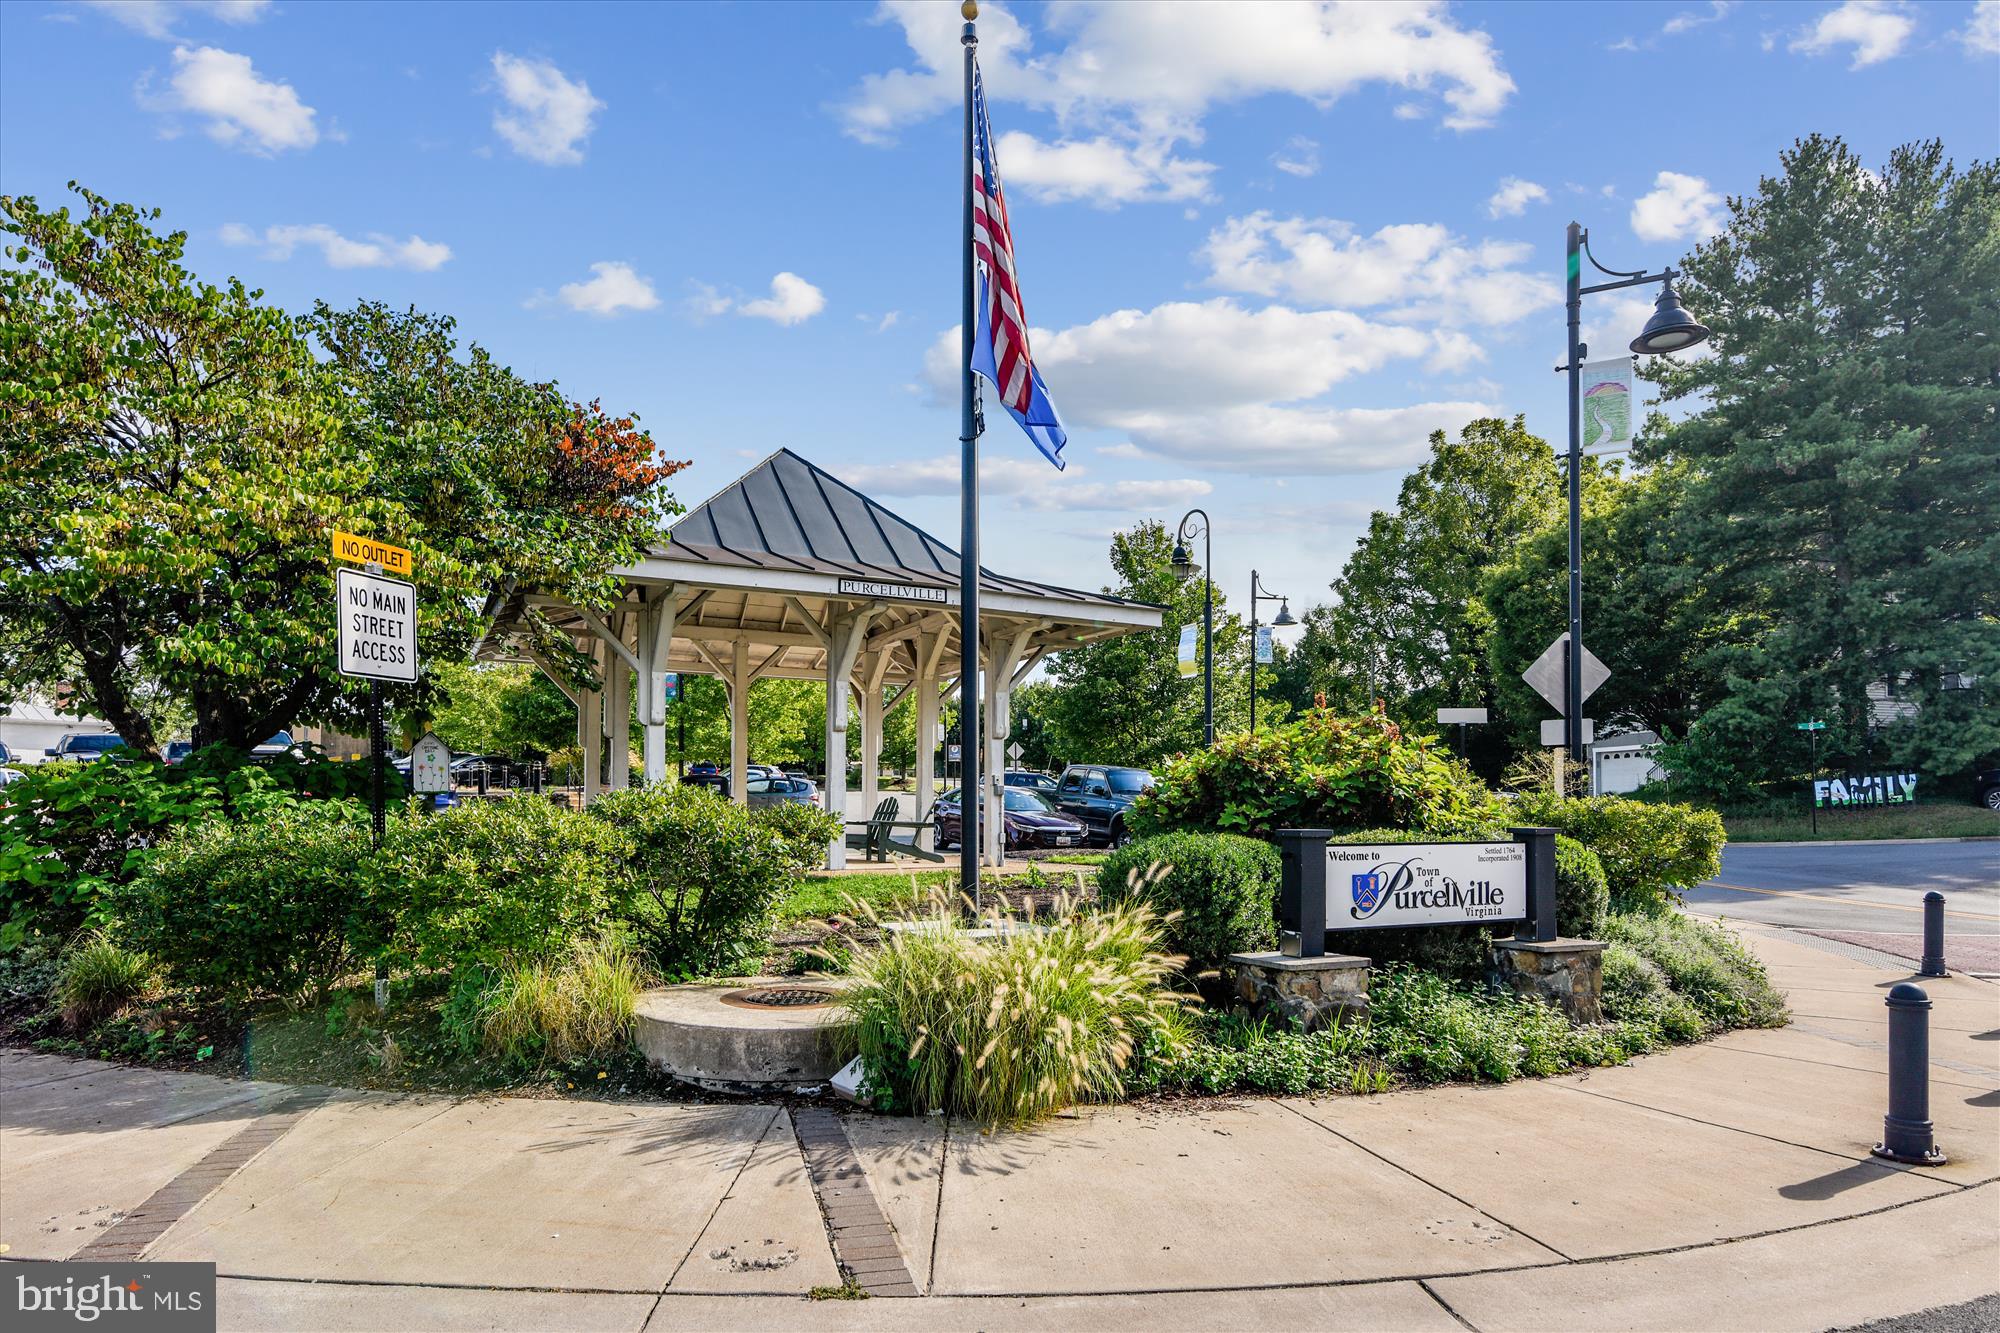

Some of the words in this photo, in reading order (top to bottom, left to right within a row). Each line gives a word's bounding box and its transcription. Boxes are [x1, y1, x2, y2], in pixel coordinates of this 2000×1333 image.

[342, 539, 359, 557] NO
[362, 545, 404, 568] OUTLET
[843, 581, 943, 600] PURCELLVILLE
[349, 586, 368, 607] NO
[373, 591, 406, 615] MAIN
[352, 613, 404, 639] STREET
[352, 639, 405, 664] ACCESS
[1814, 773, 1917, 808] FAMILY
[1328, 851, 1369, 861] Welcome
[1371, 852, 1380, 861] to
[1484, 847, 1502, 855] Settled
[1477, 855, 1509, 863] Incorporated
[1416, 867, 1440, 877] Town
[1424, 877, 1434, 887] of
[1465, 906, 1502, 918] Virginia
